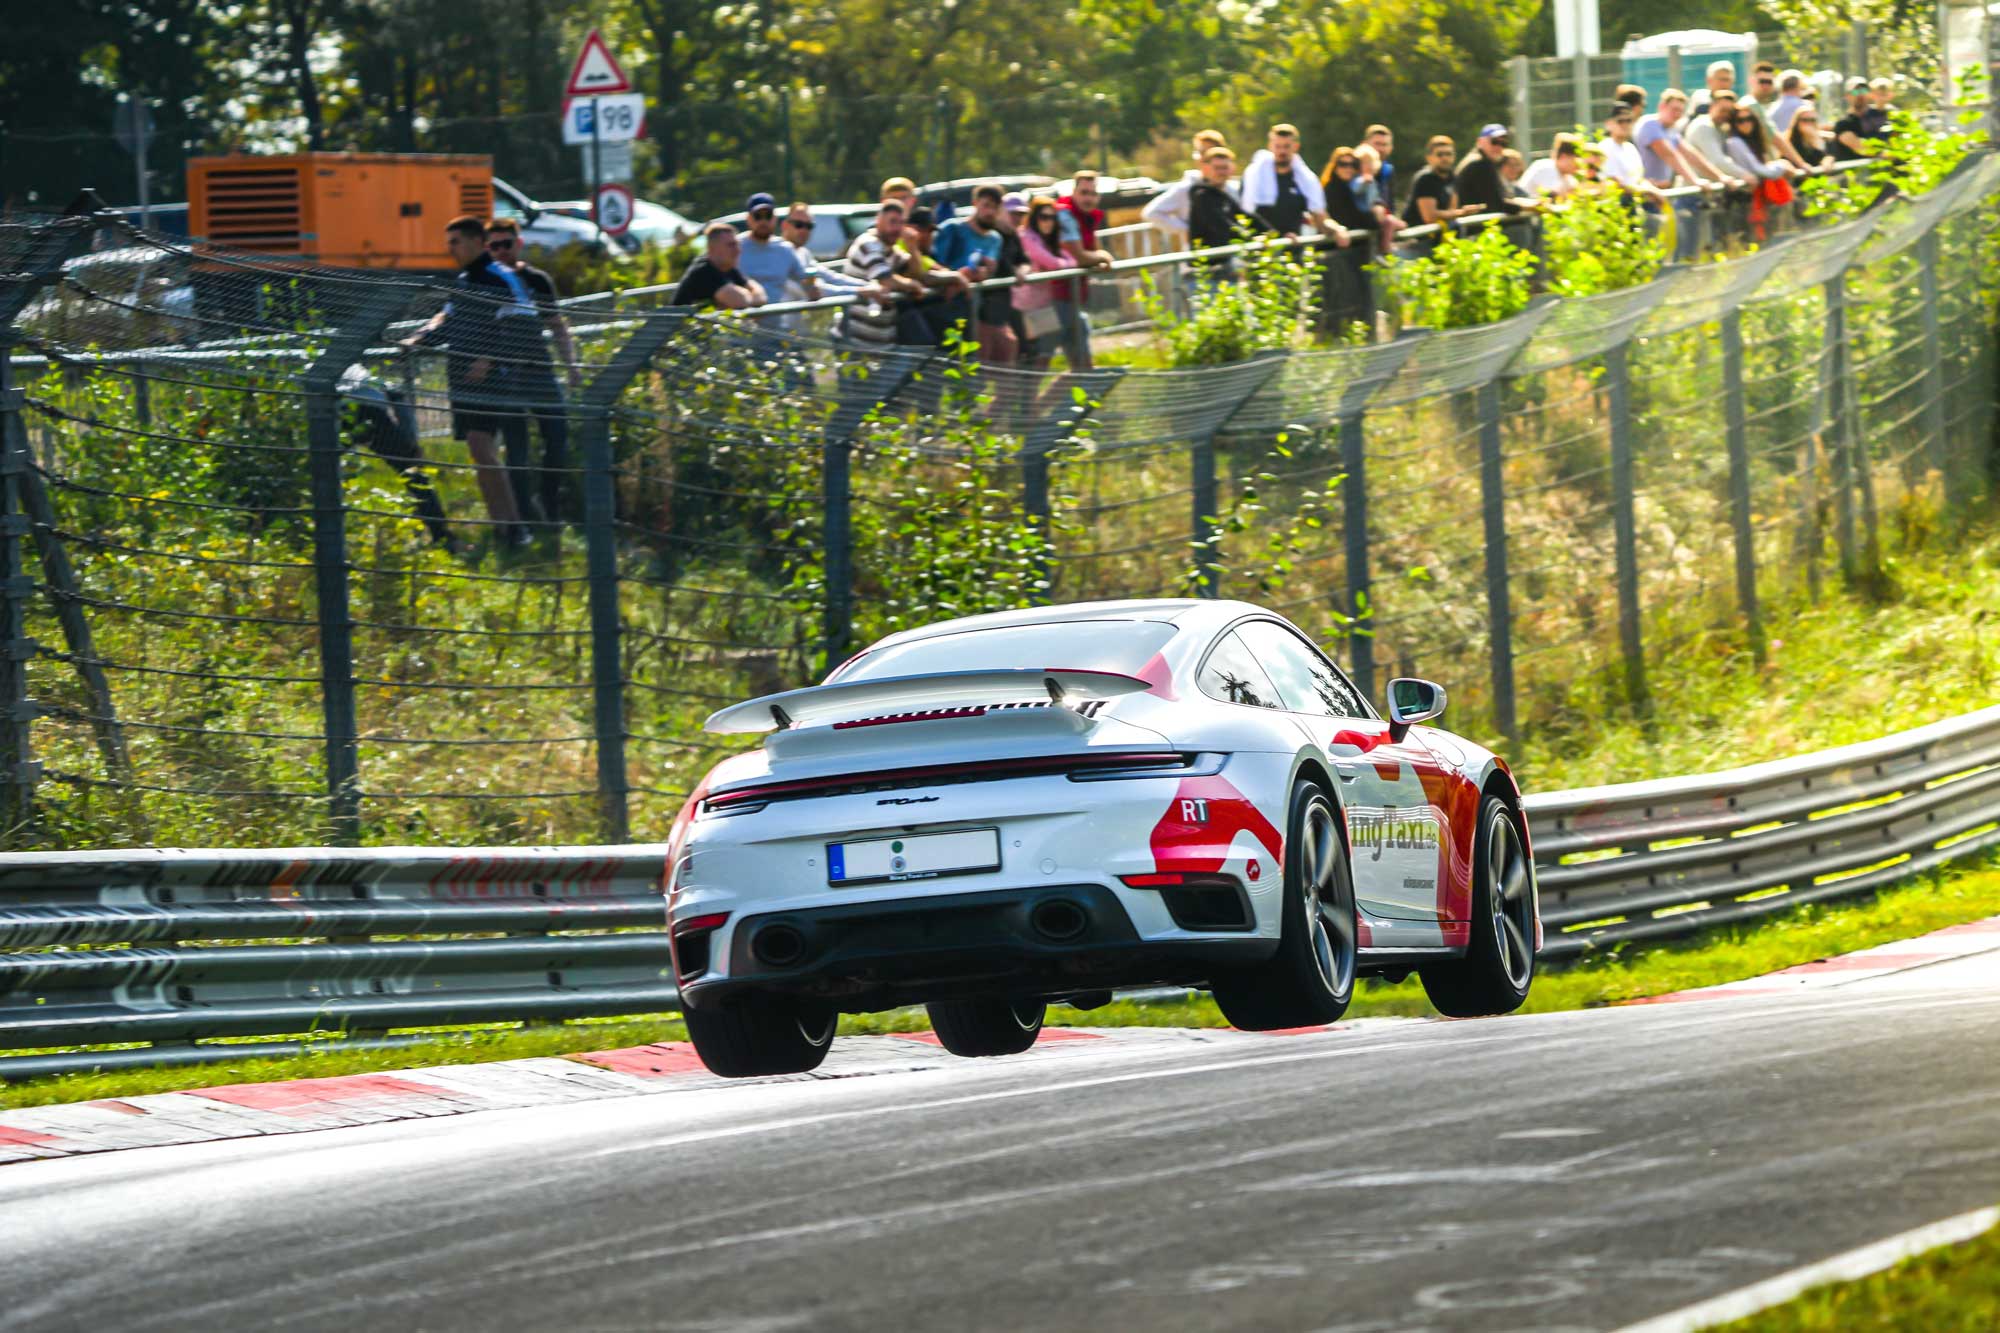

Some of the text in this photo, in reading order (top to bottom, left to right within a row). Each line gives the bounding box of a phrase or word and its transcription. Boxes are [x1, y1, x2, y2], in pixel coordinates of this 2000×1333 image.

[602, 105, 632, 130] 98
[1181, 798, 1207, 822] RT
[1346, 804, 1436, 862] ingTaxi.de
